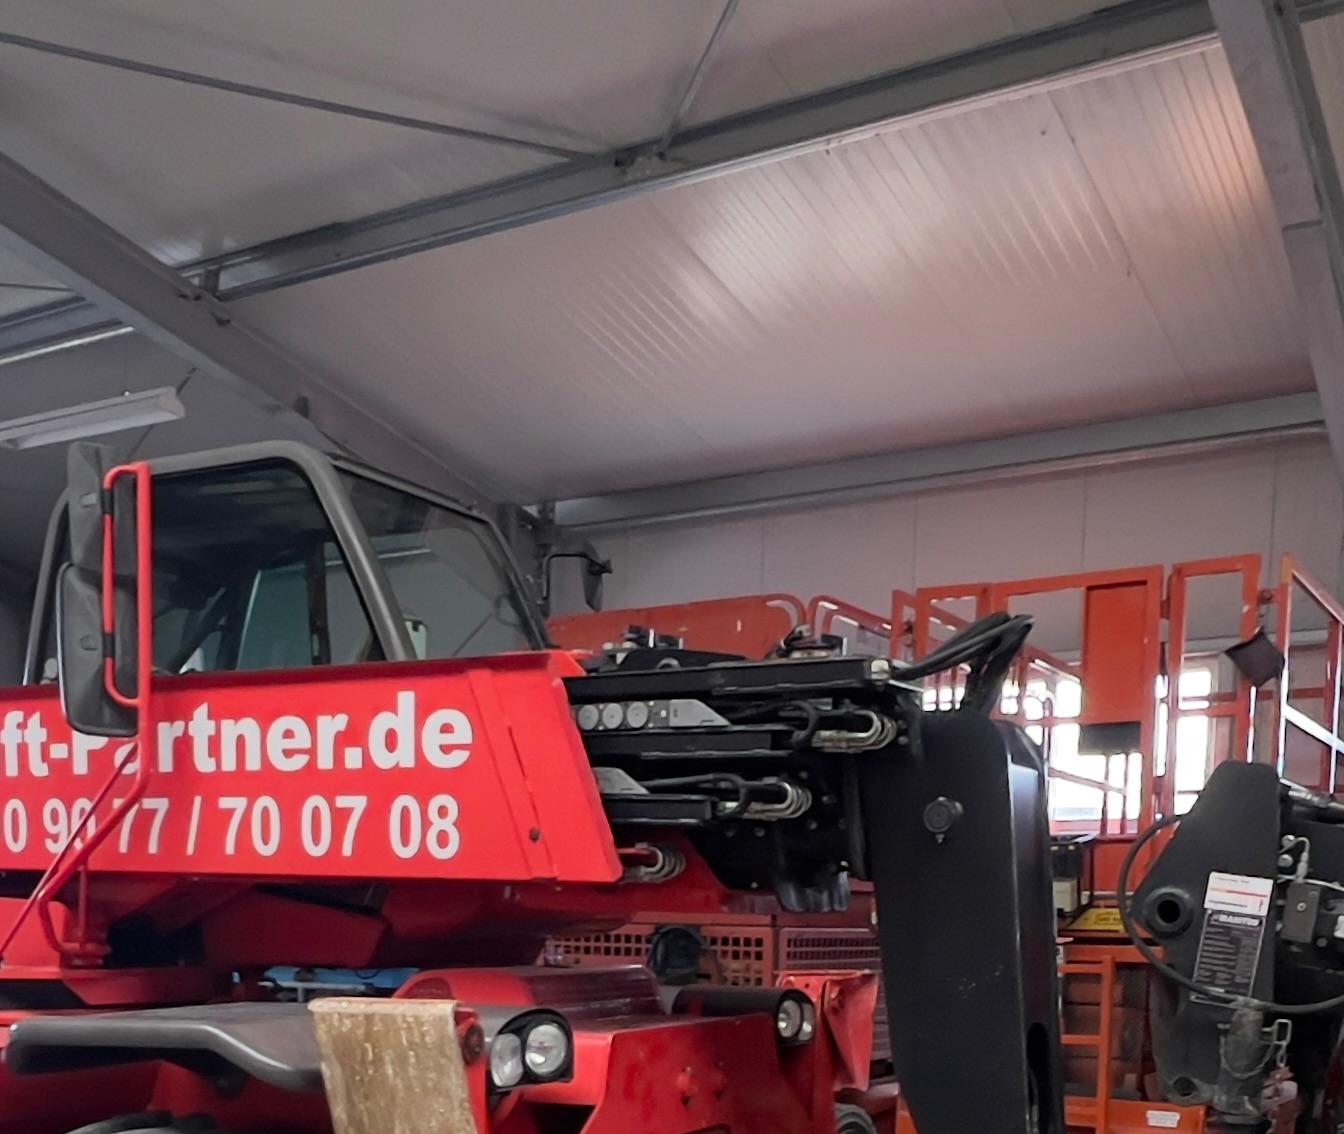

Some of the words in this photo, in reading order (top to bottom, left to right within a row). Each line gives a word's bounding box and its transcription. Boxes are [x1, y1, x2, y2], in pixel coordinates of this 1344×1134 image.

[3, 798, 27, 853] 0
[185, 795, 202, 856] /
[218, 796, 281, 858] 70
[301, 795, 367, 858] 07
[390, 794, 460, 860] 08
